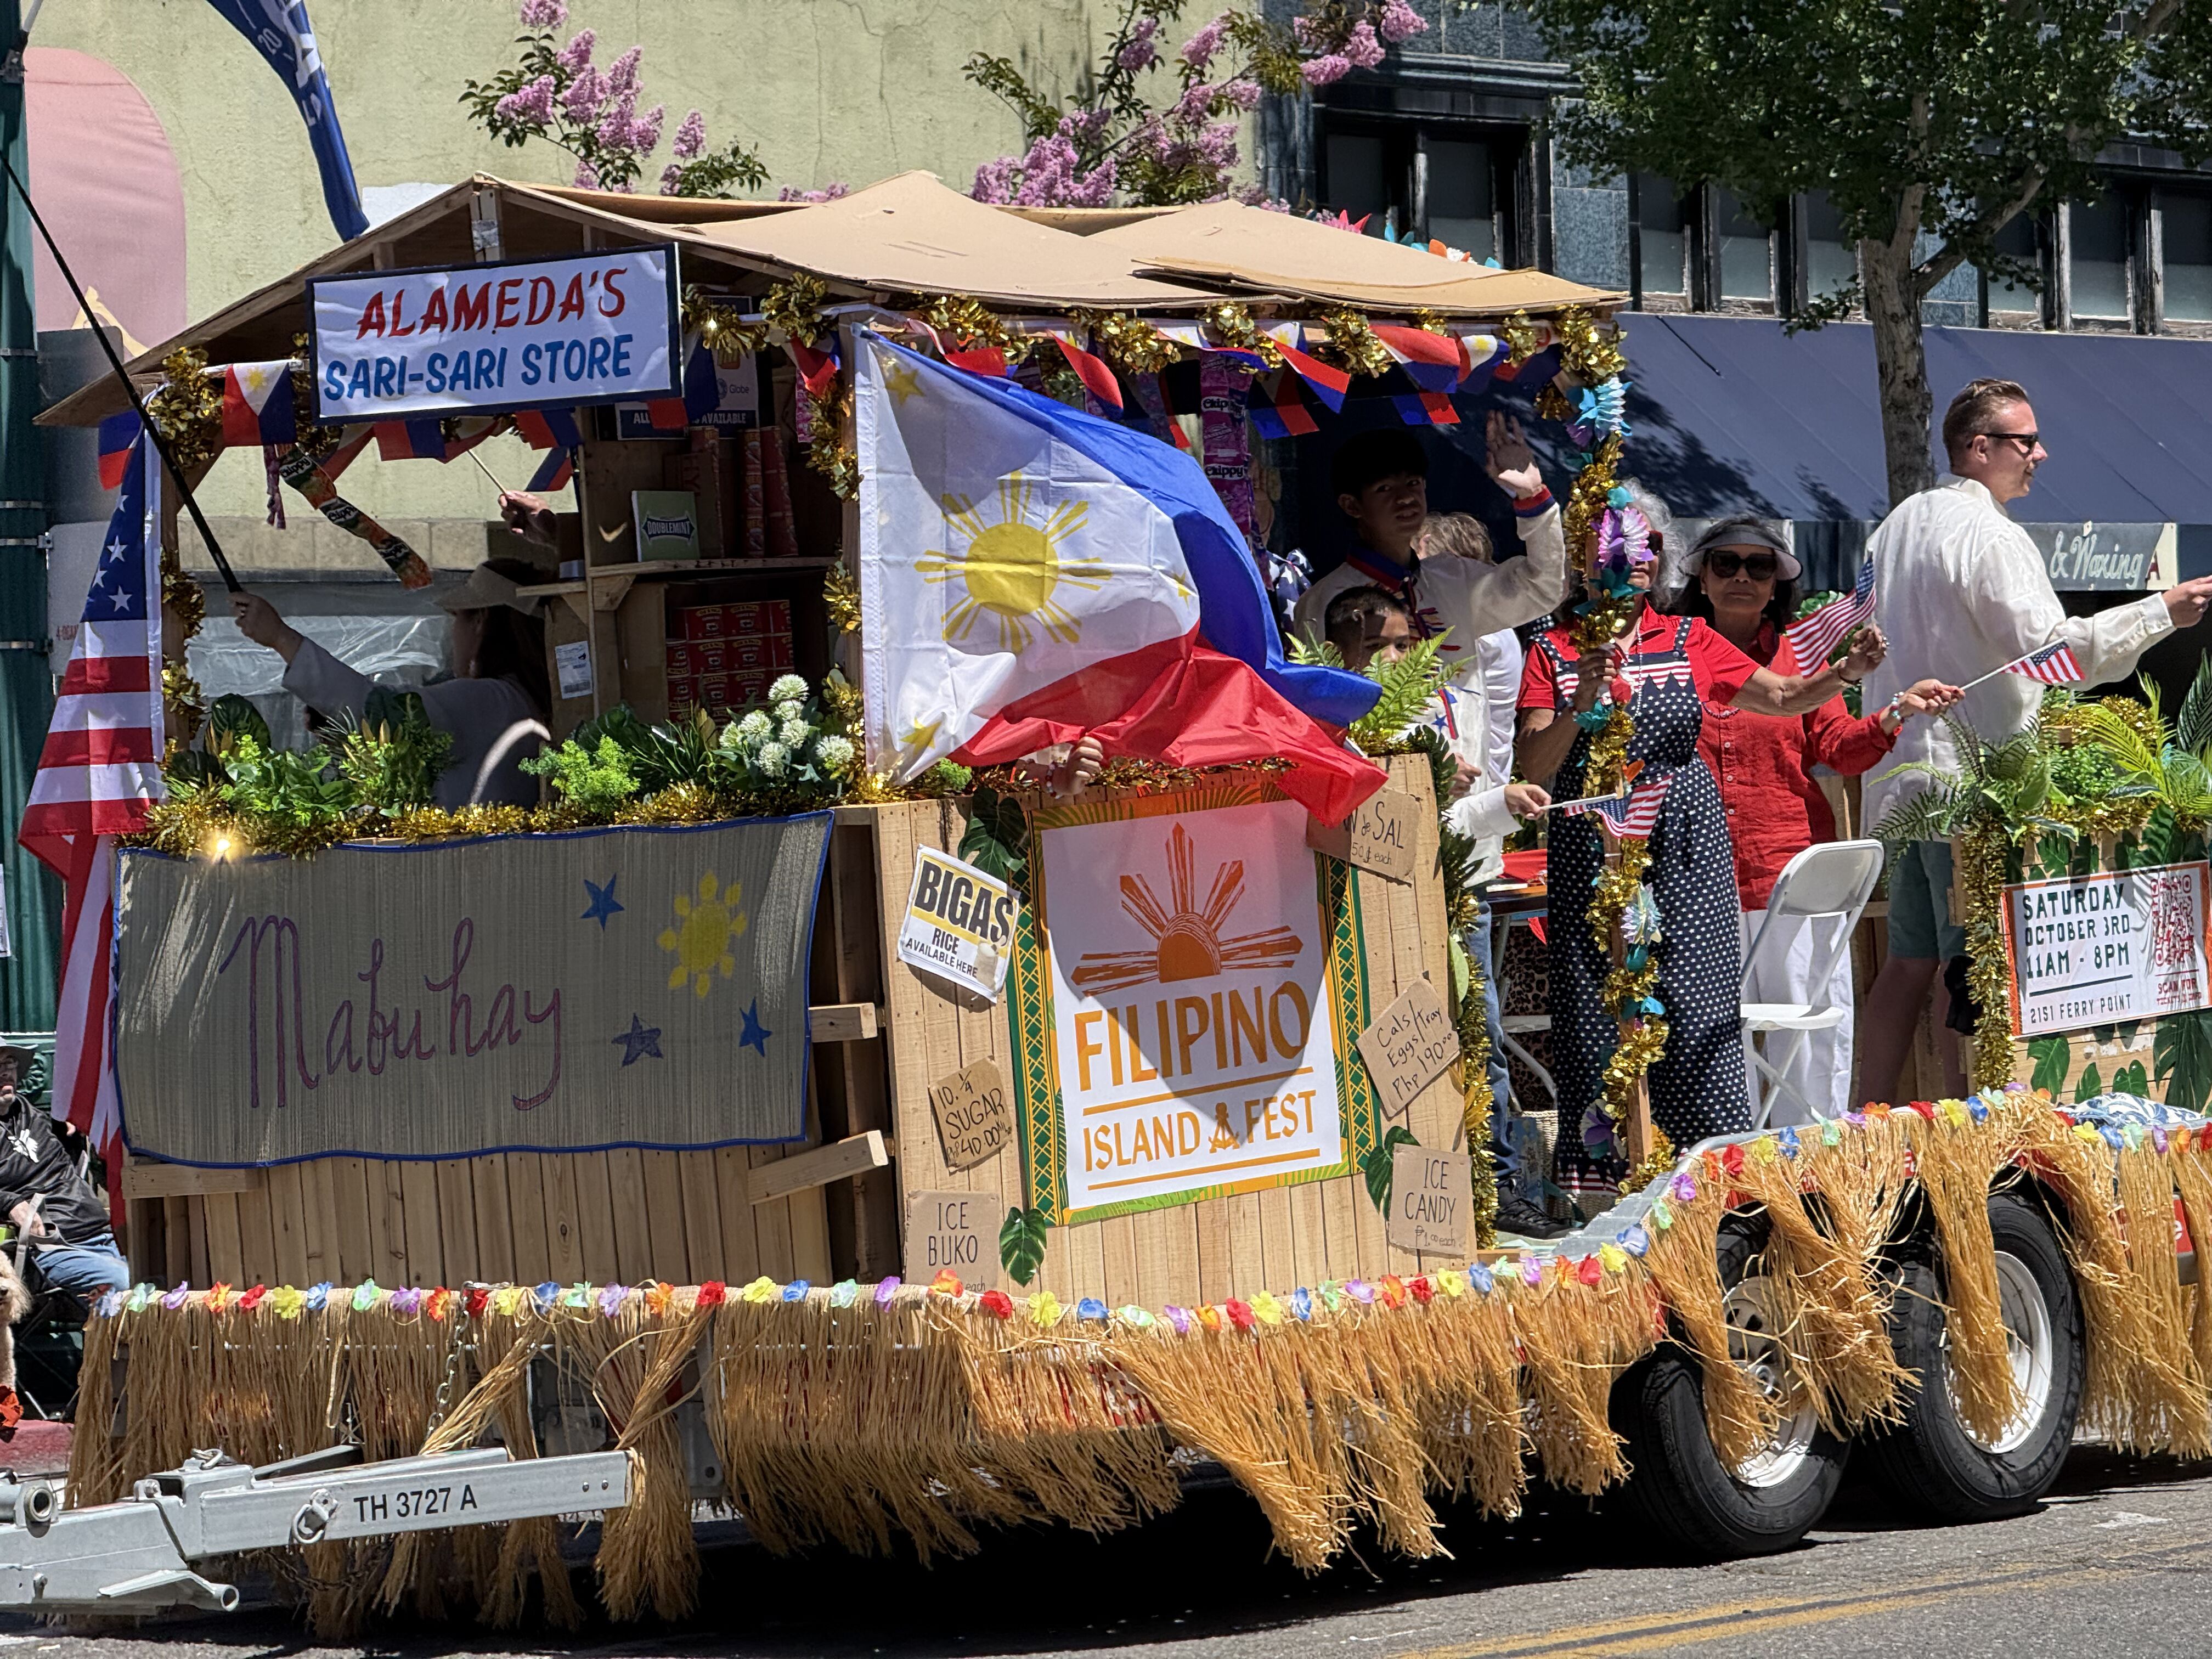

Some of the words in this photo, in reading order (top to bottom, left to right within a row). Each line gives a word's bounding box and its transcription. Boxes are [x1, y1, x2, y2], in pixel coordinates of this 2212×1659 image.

[356, 268, 628, 340] ALAMEDA'S
[324, 347, 507, 401] SARI-SARI
[521, 334, 633, 385] STORE
[729, 385, 749, 394] Globe
[701, 413, 746, 424] AVAILABLE
[647, 521, 690, 535] DOUBLEMINT
[2049, 531, 2068, 579] &
[2070, 534, 2143, 589] Waxing
[1361, 814, 1371, 836] de
[1373, 801, 1404, 849] SAL
[1374, 851, 1392, 865] each
[915, 860, 1014, 947] BIGAS
[2023, 883, 2125, 921] SATURDAY
[932, 928, 960, 955] RICE
[2025, 918, 2097, 947] OCTOBER
[2103, 913, 2130, 936] 3RD
[905, 938, 955, 968] AVAILABLE
[956, 960, 978, 978] HERE
[2027, 949, 2070, 979] 11AM
[2094, 941, 2130, 969] 8PM
[2158, 980, 2179, 994] SCAN
[219, 915, 562, 1111] Mabuhay
[2030, 1005, 2054, 1024] 2151
[2059, 998, 2094, 1019] FERRY
[2100, 994, 2131, 1013] POINT
[1074, 980, 1310, 1092] FILIPINO
[1387, 1034, 1419, 1068] Eggs
[1392, 1073, 1419, 1101] Php
[945, 1087, 1005, 1139] SUGAR
[1082, 1111, 1201, 1172] ISLAND
[1244, 1089, 1317, 1144] FEST
[1423, 1158, 1449, 1190] ICE
[938, 1201, 969, 1231] ICE
[1404, 1192, 1457, 1226] CANDY
[928, 1234, 978, 1266] BUKO
[1439, 1228, 1456, 1247] each
[965, 1275, 986, 1293] each
[353, 1494, 387, 1522] TH
[396, 1487, 451, 1518] 3727
[460, 1485, 478, 1510] A
